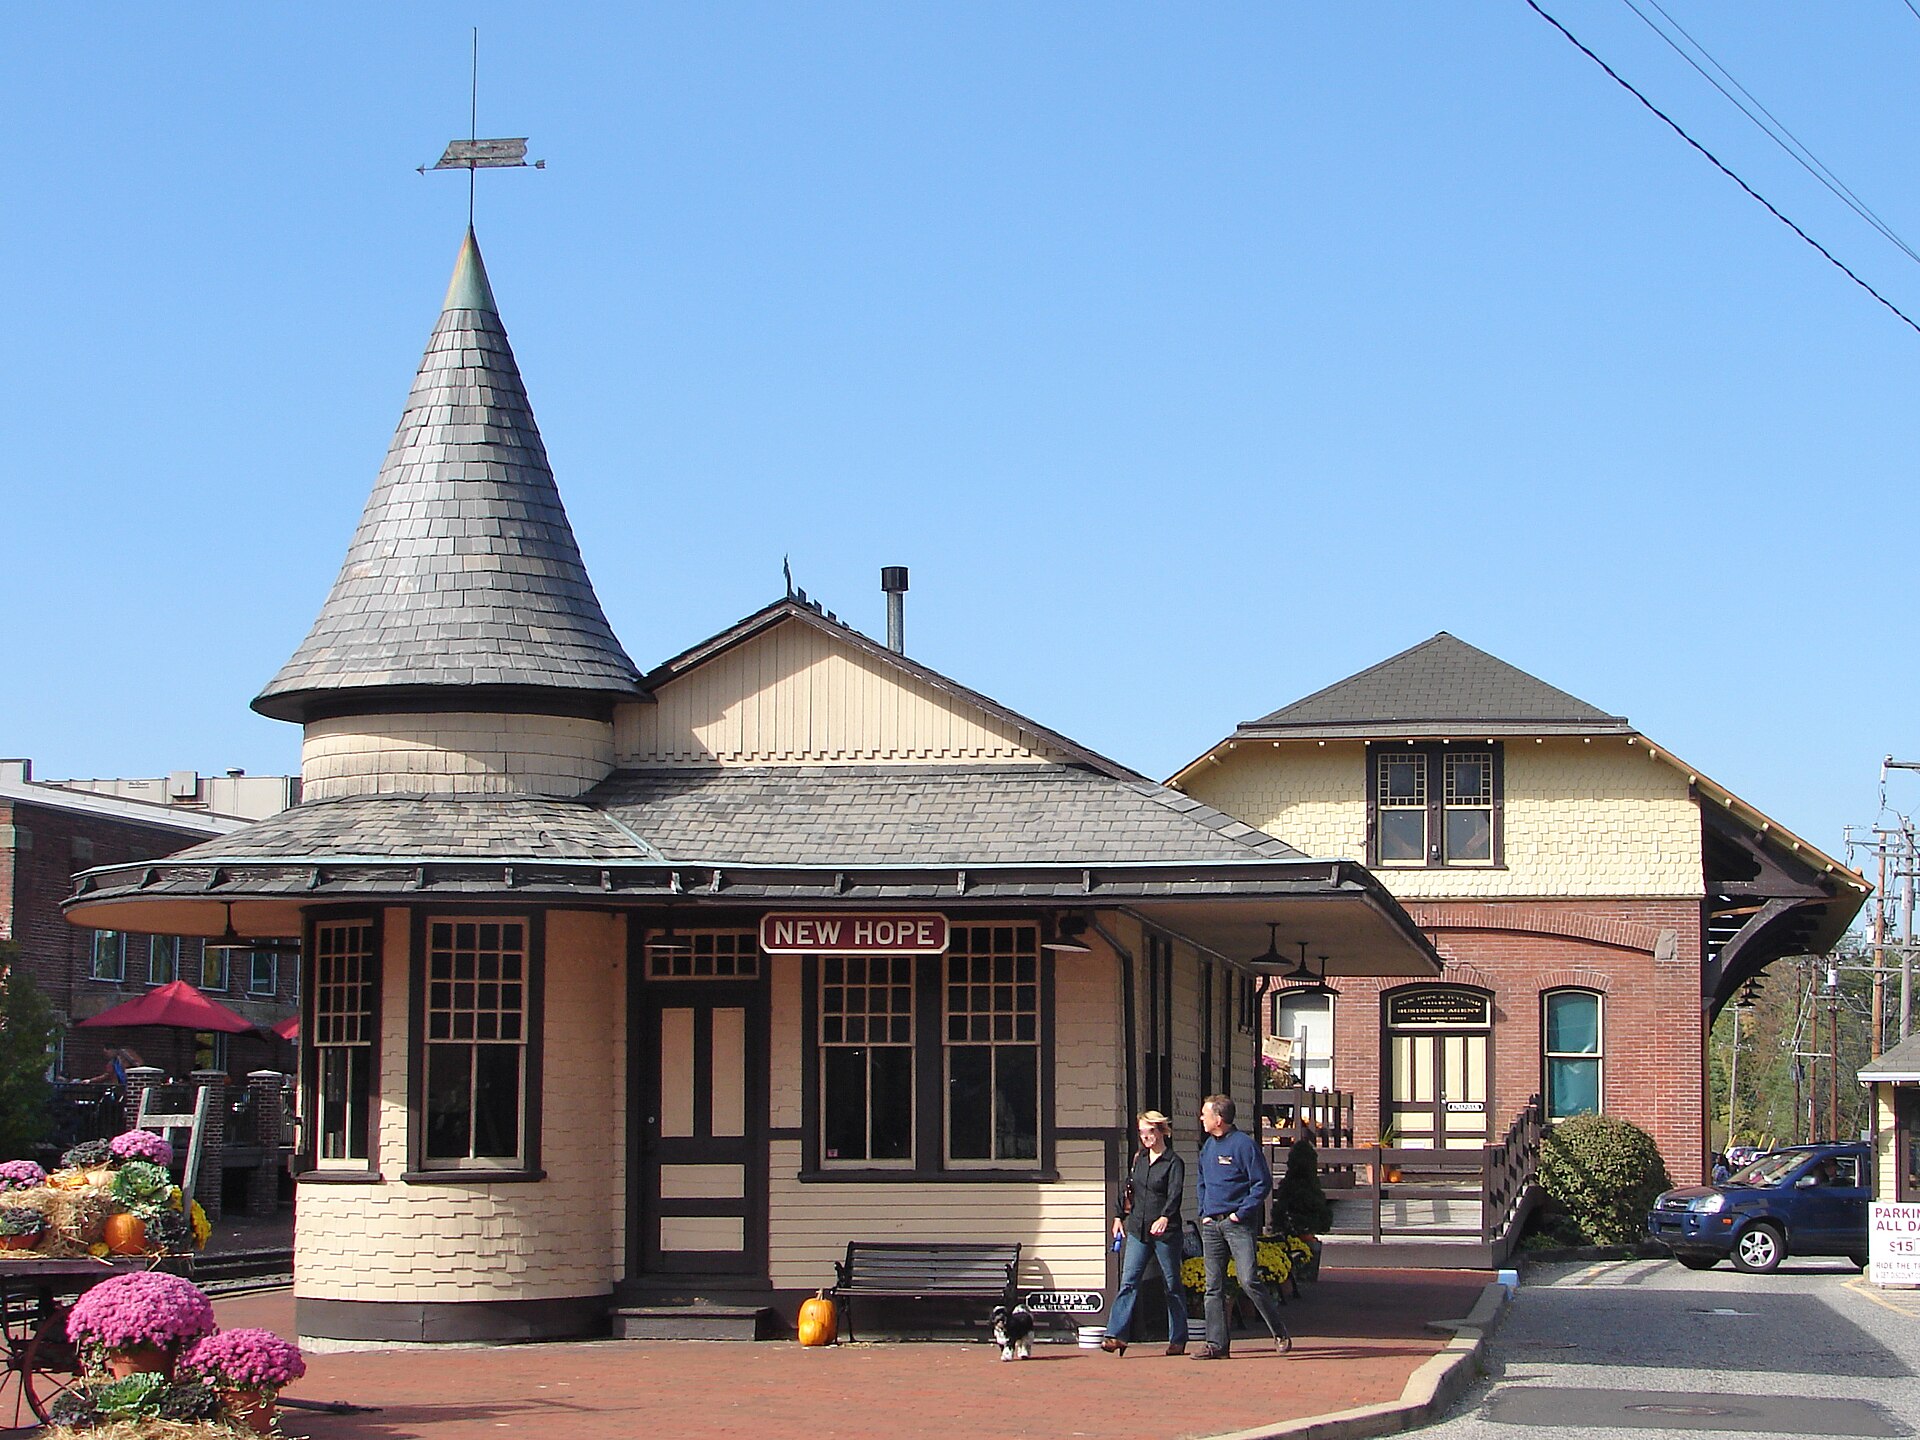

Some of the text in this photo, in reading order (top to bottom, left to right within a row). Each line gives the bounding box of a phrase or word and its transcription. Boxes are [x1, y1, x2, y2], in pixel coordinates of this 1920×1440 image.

[774, 921, 935, 945] NEW HOPE
[1876, 1220, 1902, 1231] ALL
[1889, 1241, 1913, 1252] $15
[1876, 1262, 1893, 1270] RIDE
[1896, 1262, 1911, 1270] THE
[1039, 1294, 1090, 1305] PUPPY
